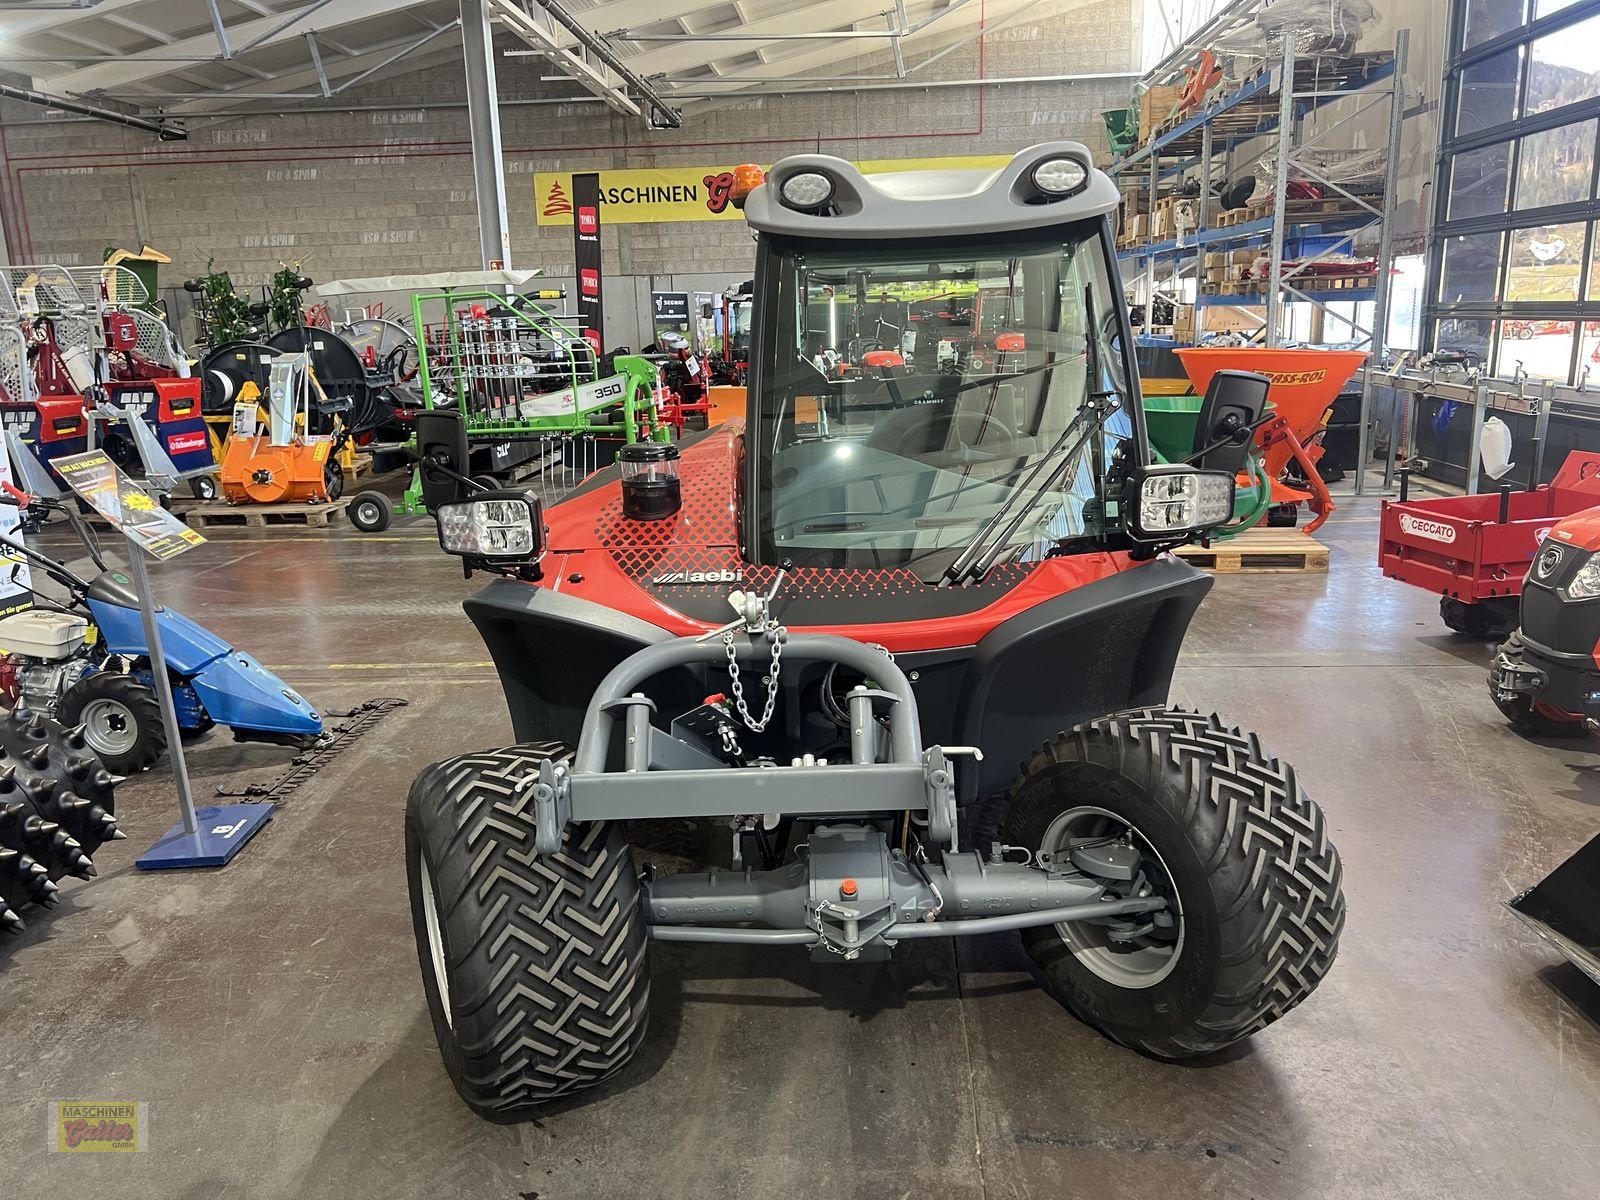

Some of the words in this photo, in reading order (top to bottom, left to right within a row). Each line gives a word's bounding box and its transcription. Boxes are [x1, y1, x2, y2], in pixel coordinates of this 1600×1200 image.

[597, 185, 697, 205] ASCHINEN
[594, 384, 622, 399] 350
[1411, 520, 1454, 538] CECCATO
[690, 569, 742, 582] aebi
